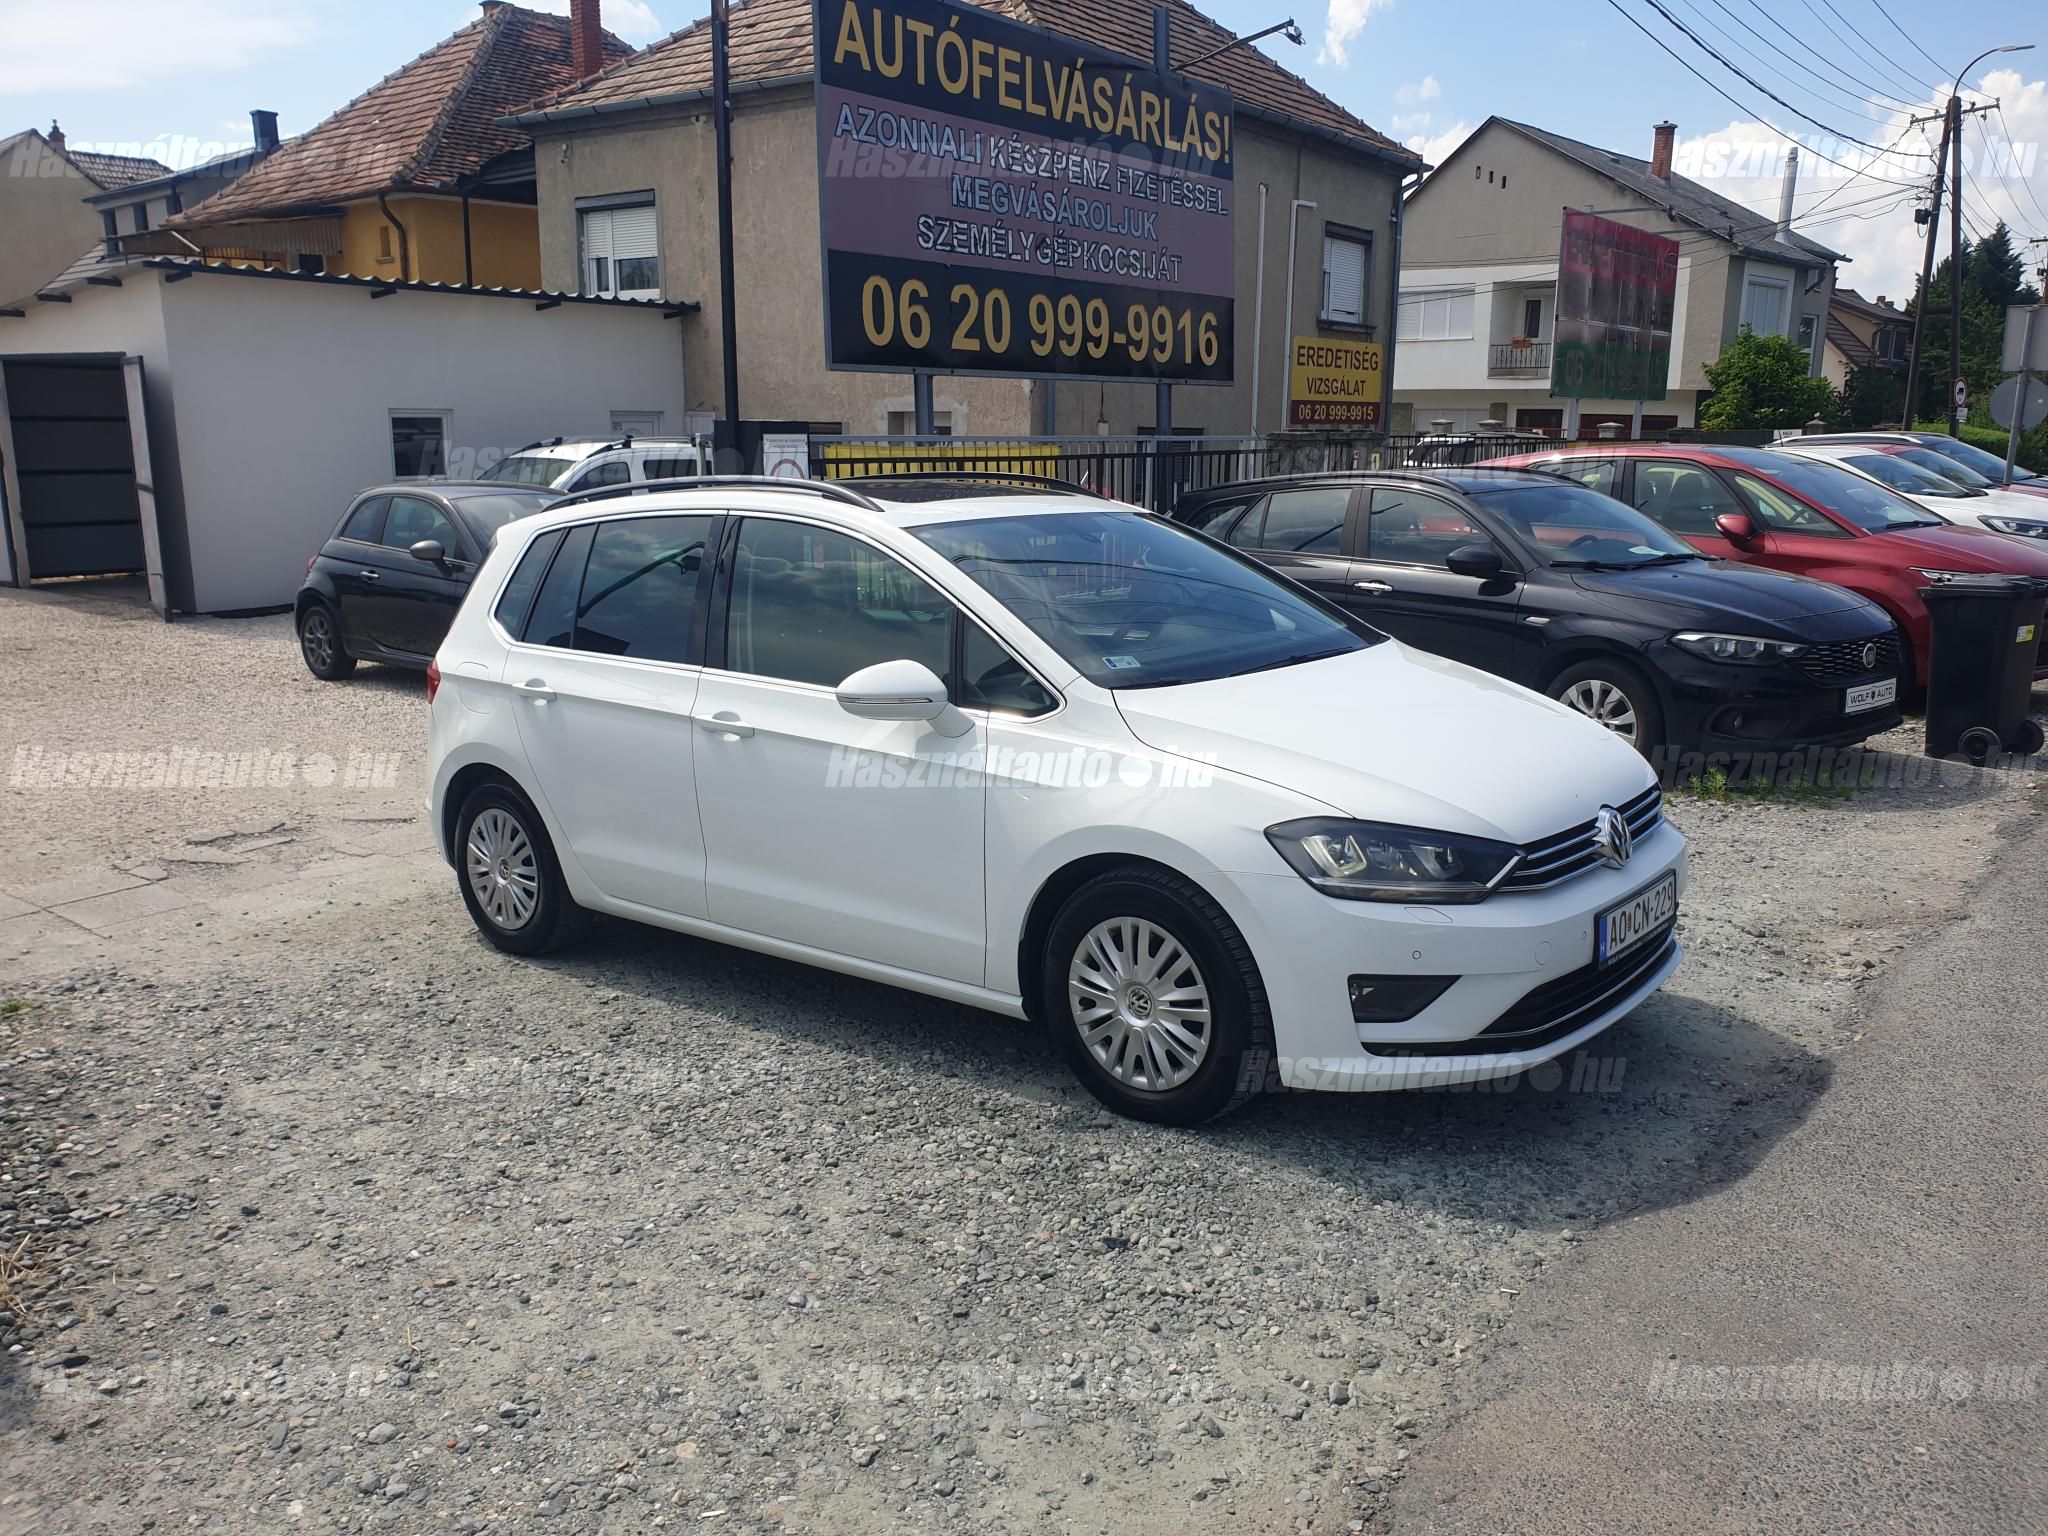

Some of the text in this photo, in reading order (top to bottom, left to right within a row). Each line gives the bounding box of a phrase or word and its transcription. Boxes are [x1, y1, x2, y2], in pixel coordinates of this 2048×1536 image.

[834, 1, 1230, 164] AUTÓFELVÁSÁRLÁS!
[835, 103, 1229, 216] AZONNALI KÉSZPÉNZ FIZETÉSSEL
[951, 173, 1159, 241] MEGVÁSÁROLJUK
[861, 273, 1219, 366] 06 20 999-9916
[1296, 345, 1379, 371] EREDETISÉG
[1306, 375, 1367, 396] VIZSGÁLAT
[1298, 404, 1374, 420] 06 20 999-9915
[1850, 687, 1893, 704] WOLF AUTO
